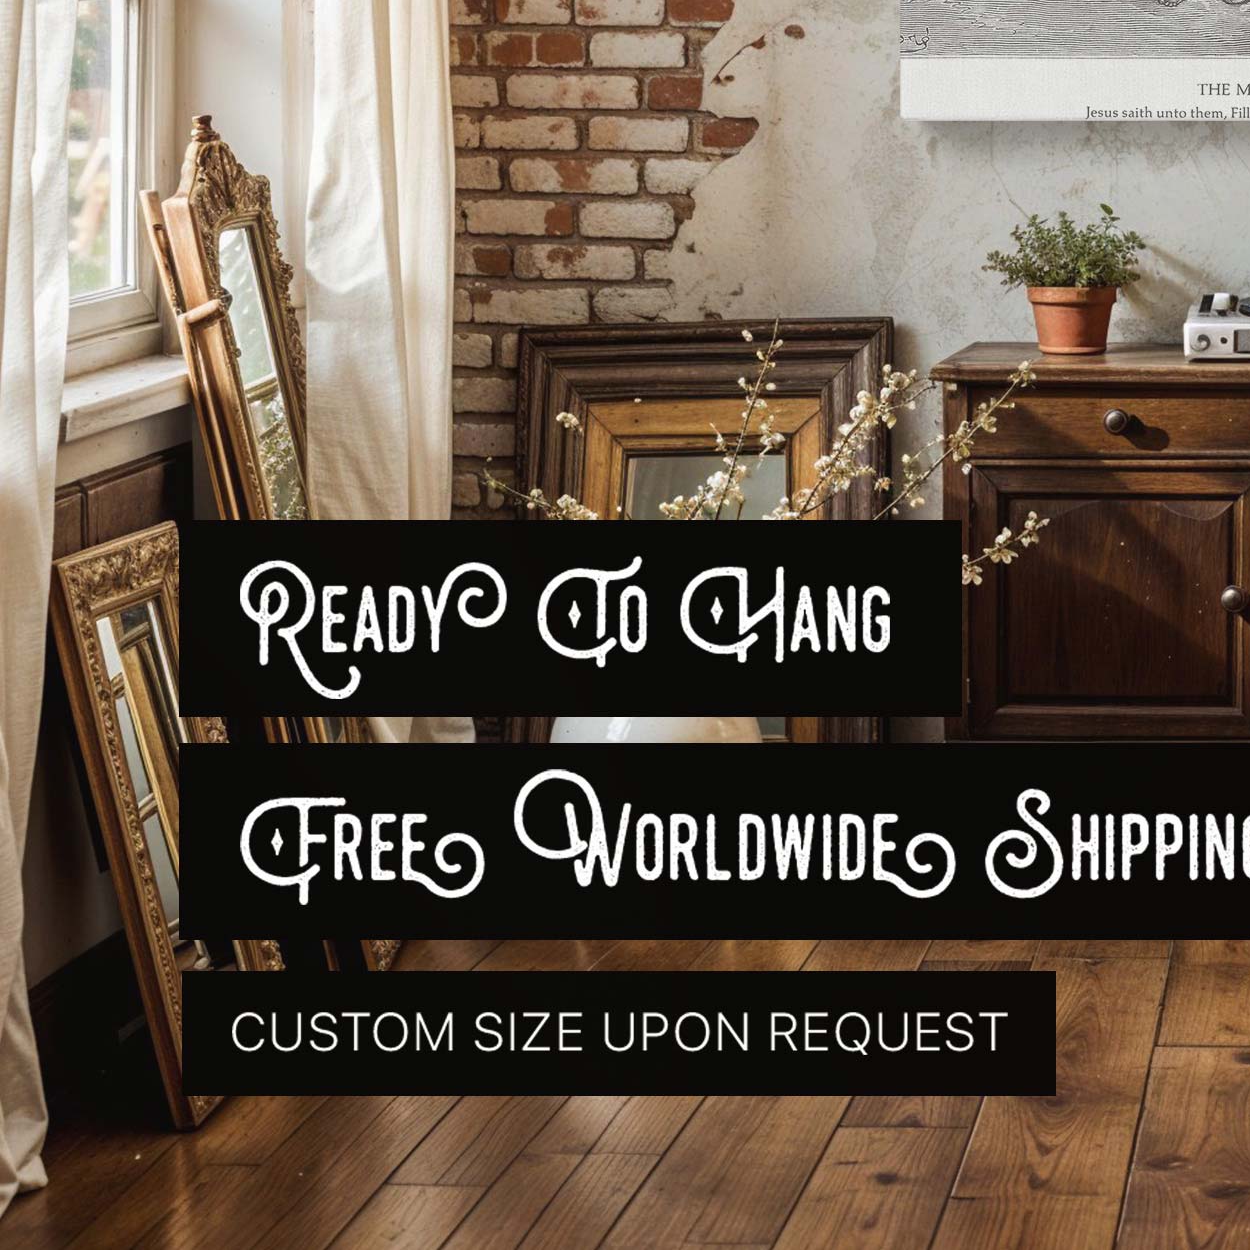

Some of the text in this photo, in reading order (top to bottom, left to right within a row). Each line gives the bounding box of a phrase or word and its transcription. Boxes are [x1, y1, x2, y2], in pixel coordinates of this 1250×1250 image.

[1197, 83, 1231, 96] THE
[1085, 105, 1119, 120] Jesus
[1121, 105, 1153, 119] saith
[1156, 107, 1187, 119] unto
[1190, 106, 1228, 120] them,
[1231, 106, 1250, 119] Fill
